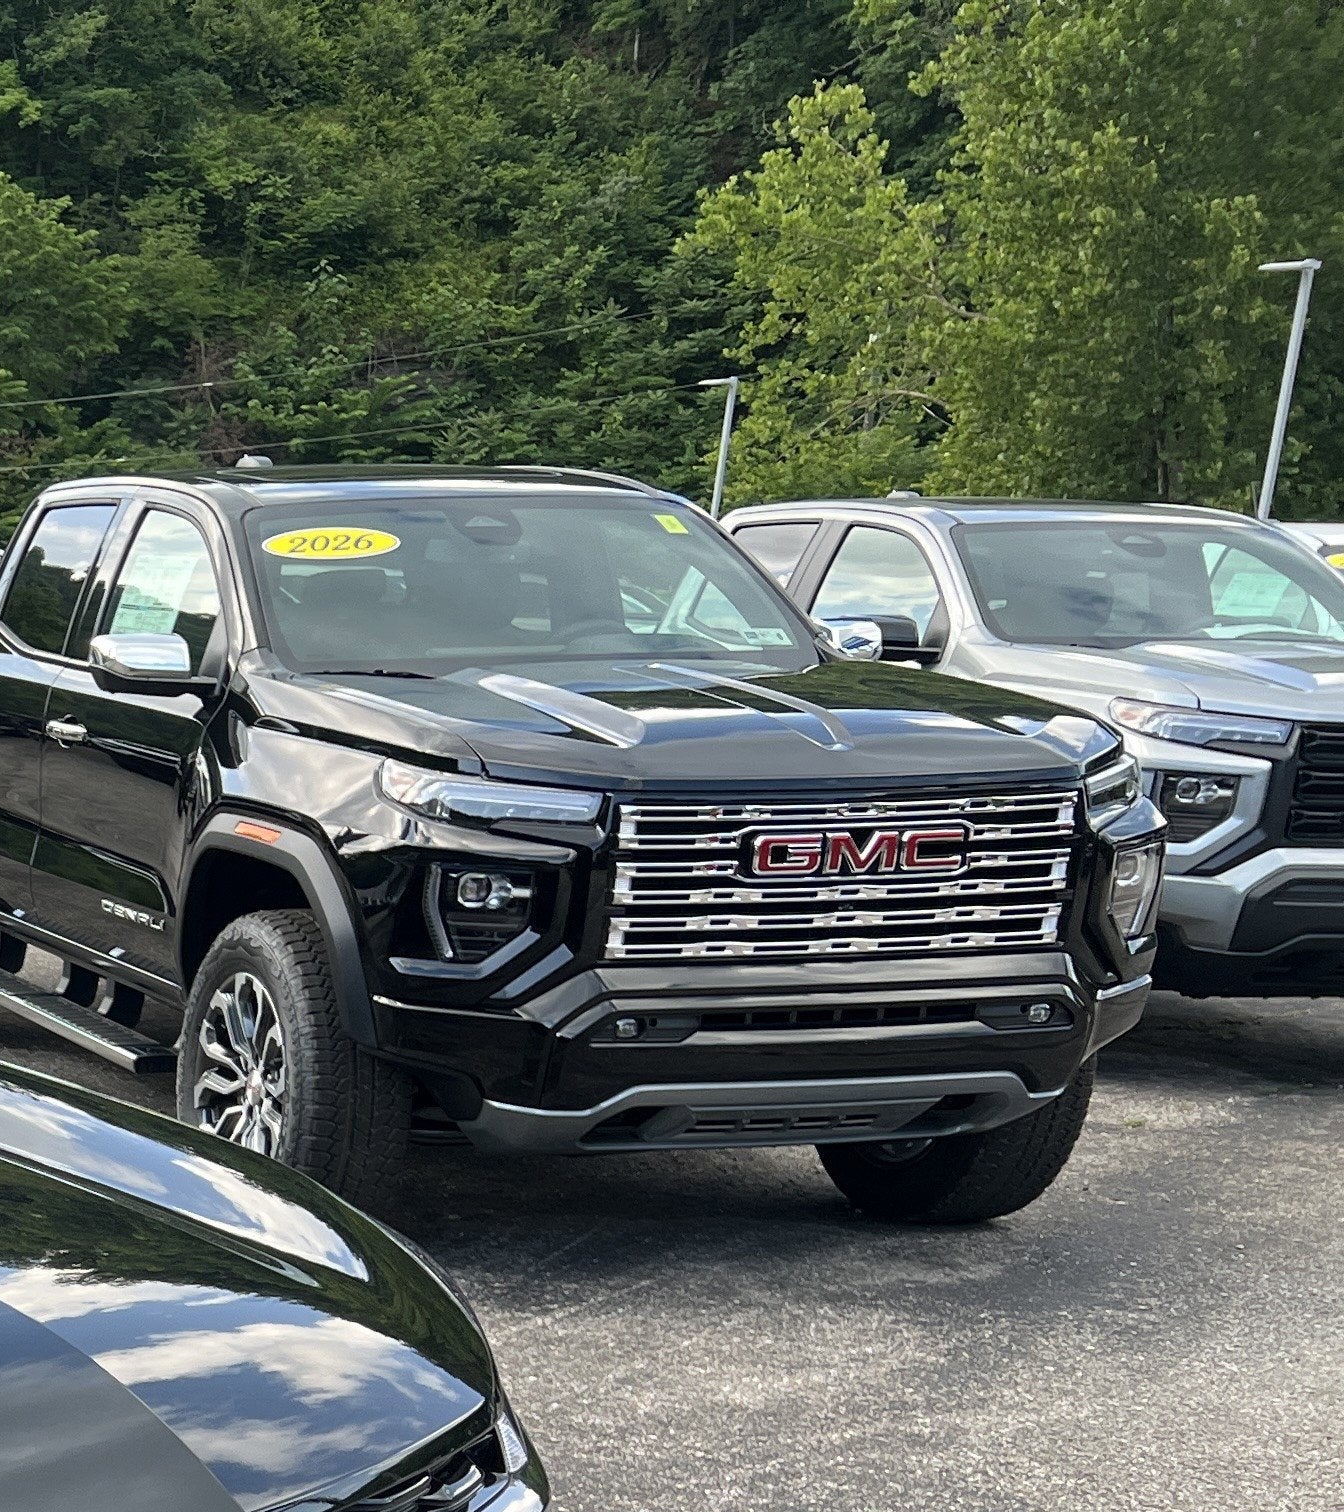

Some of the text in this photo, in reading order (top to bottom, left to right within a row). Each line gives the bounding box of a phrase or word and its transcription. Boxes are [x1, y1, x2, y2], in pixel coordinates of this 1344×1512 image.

[288, 533, 374, 554] 2026
[751, 828, 965, 876] GMC
[100, 899, 165, 932] DENALI
